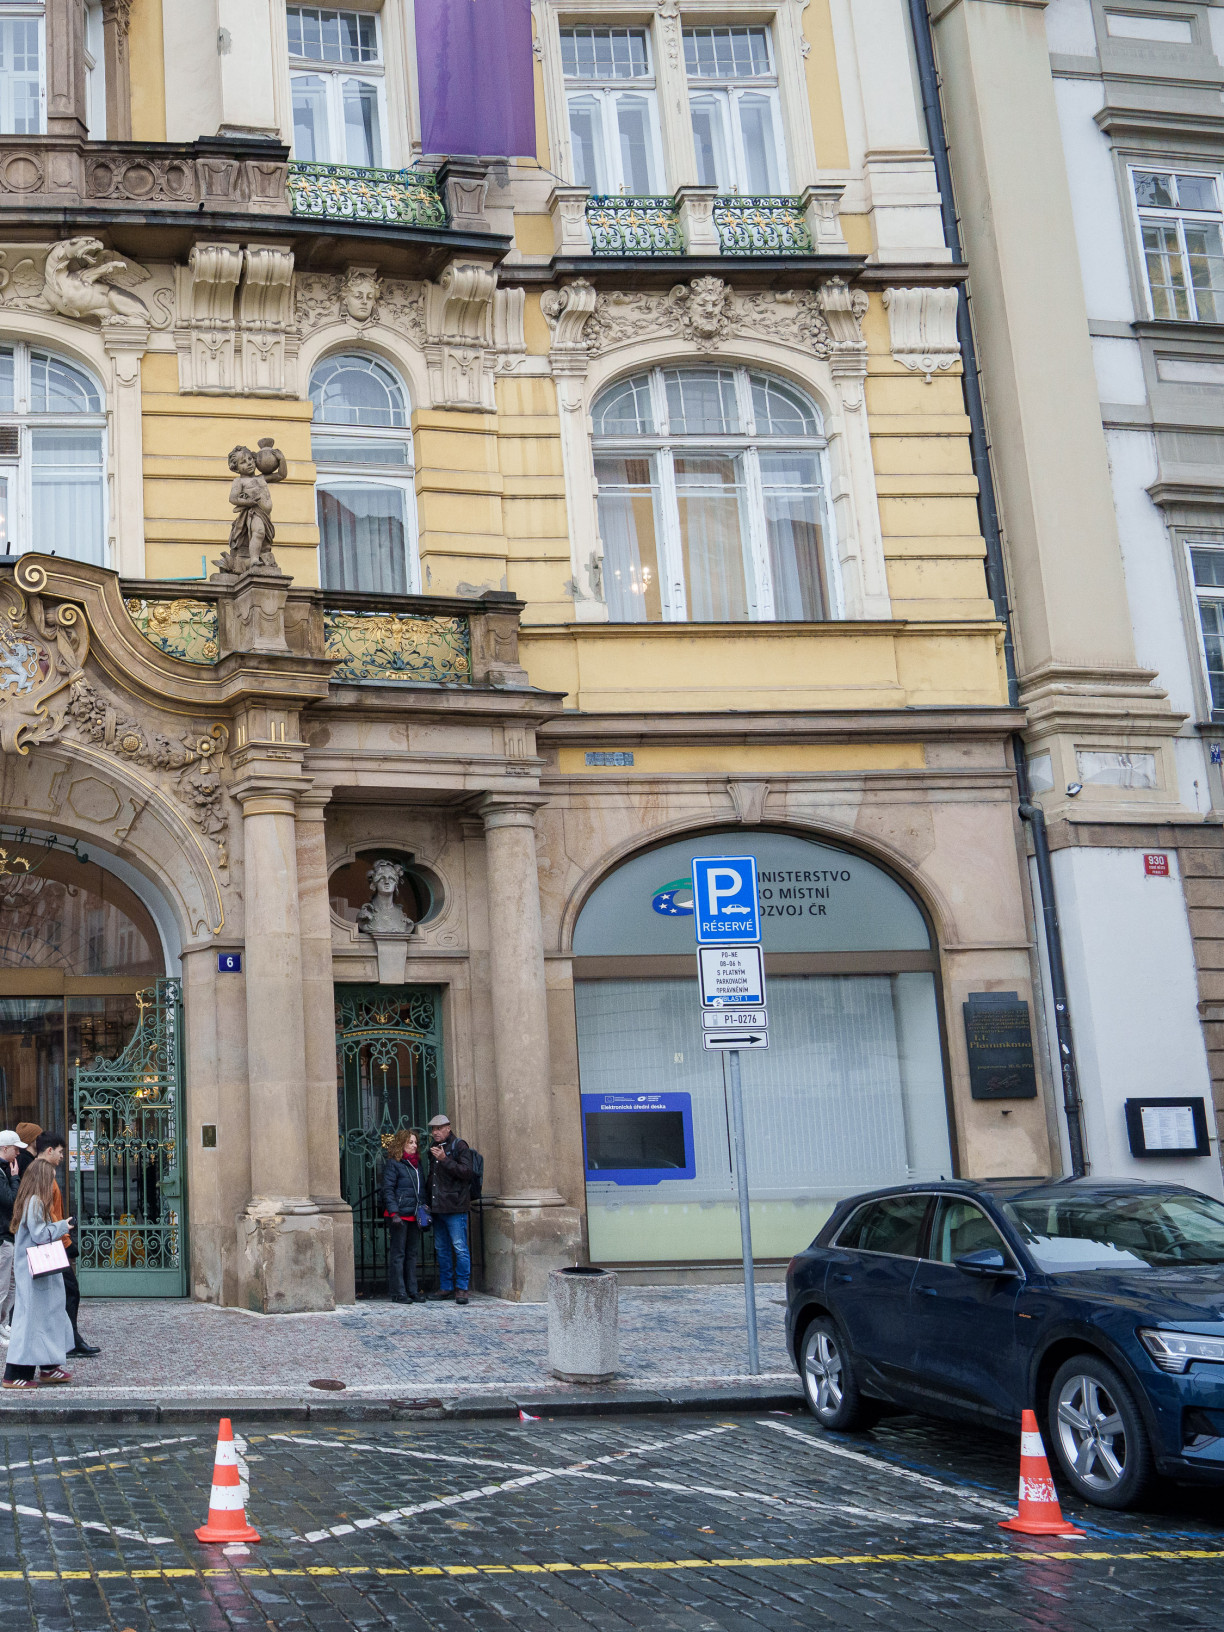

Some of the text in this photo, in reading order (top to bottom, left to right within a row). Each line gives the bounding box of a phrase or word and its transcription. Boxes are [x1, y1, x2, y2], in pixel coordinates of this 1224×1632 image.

[1148, 855, 1164, 865] 930
[757, 870, 851, 883] INISTERSTVO
[706, 867, 743, 915] P
[779, 885, 830, 899] MÍSTNÍ
[759, 902, 827, 917] OZVOJ ČR
[702, 918, 754, 932] RÉSERVÉ
[226, 956, 234, 968] 6
[722, 968, 746, 976] PLATNÝM
[724, 1014, 757, 1024] P1-0276
